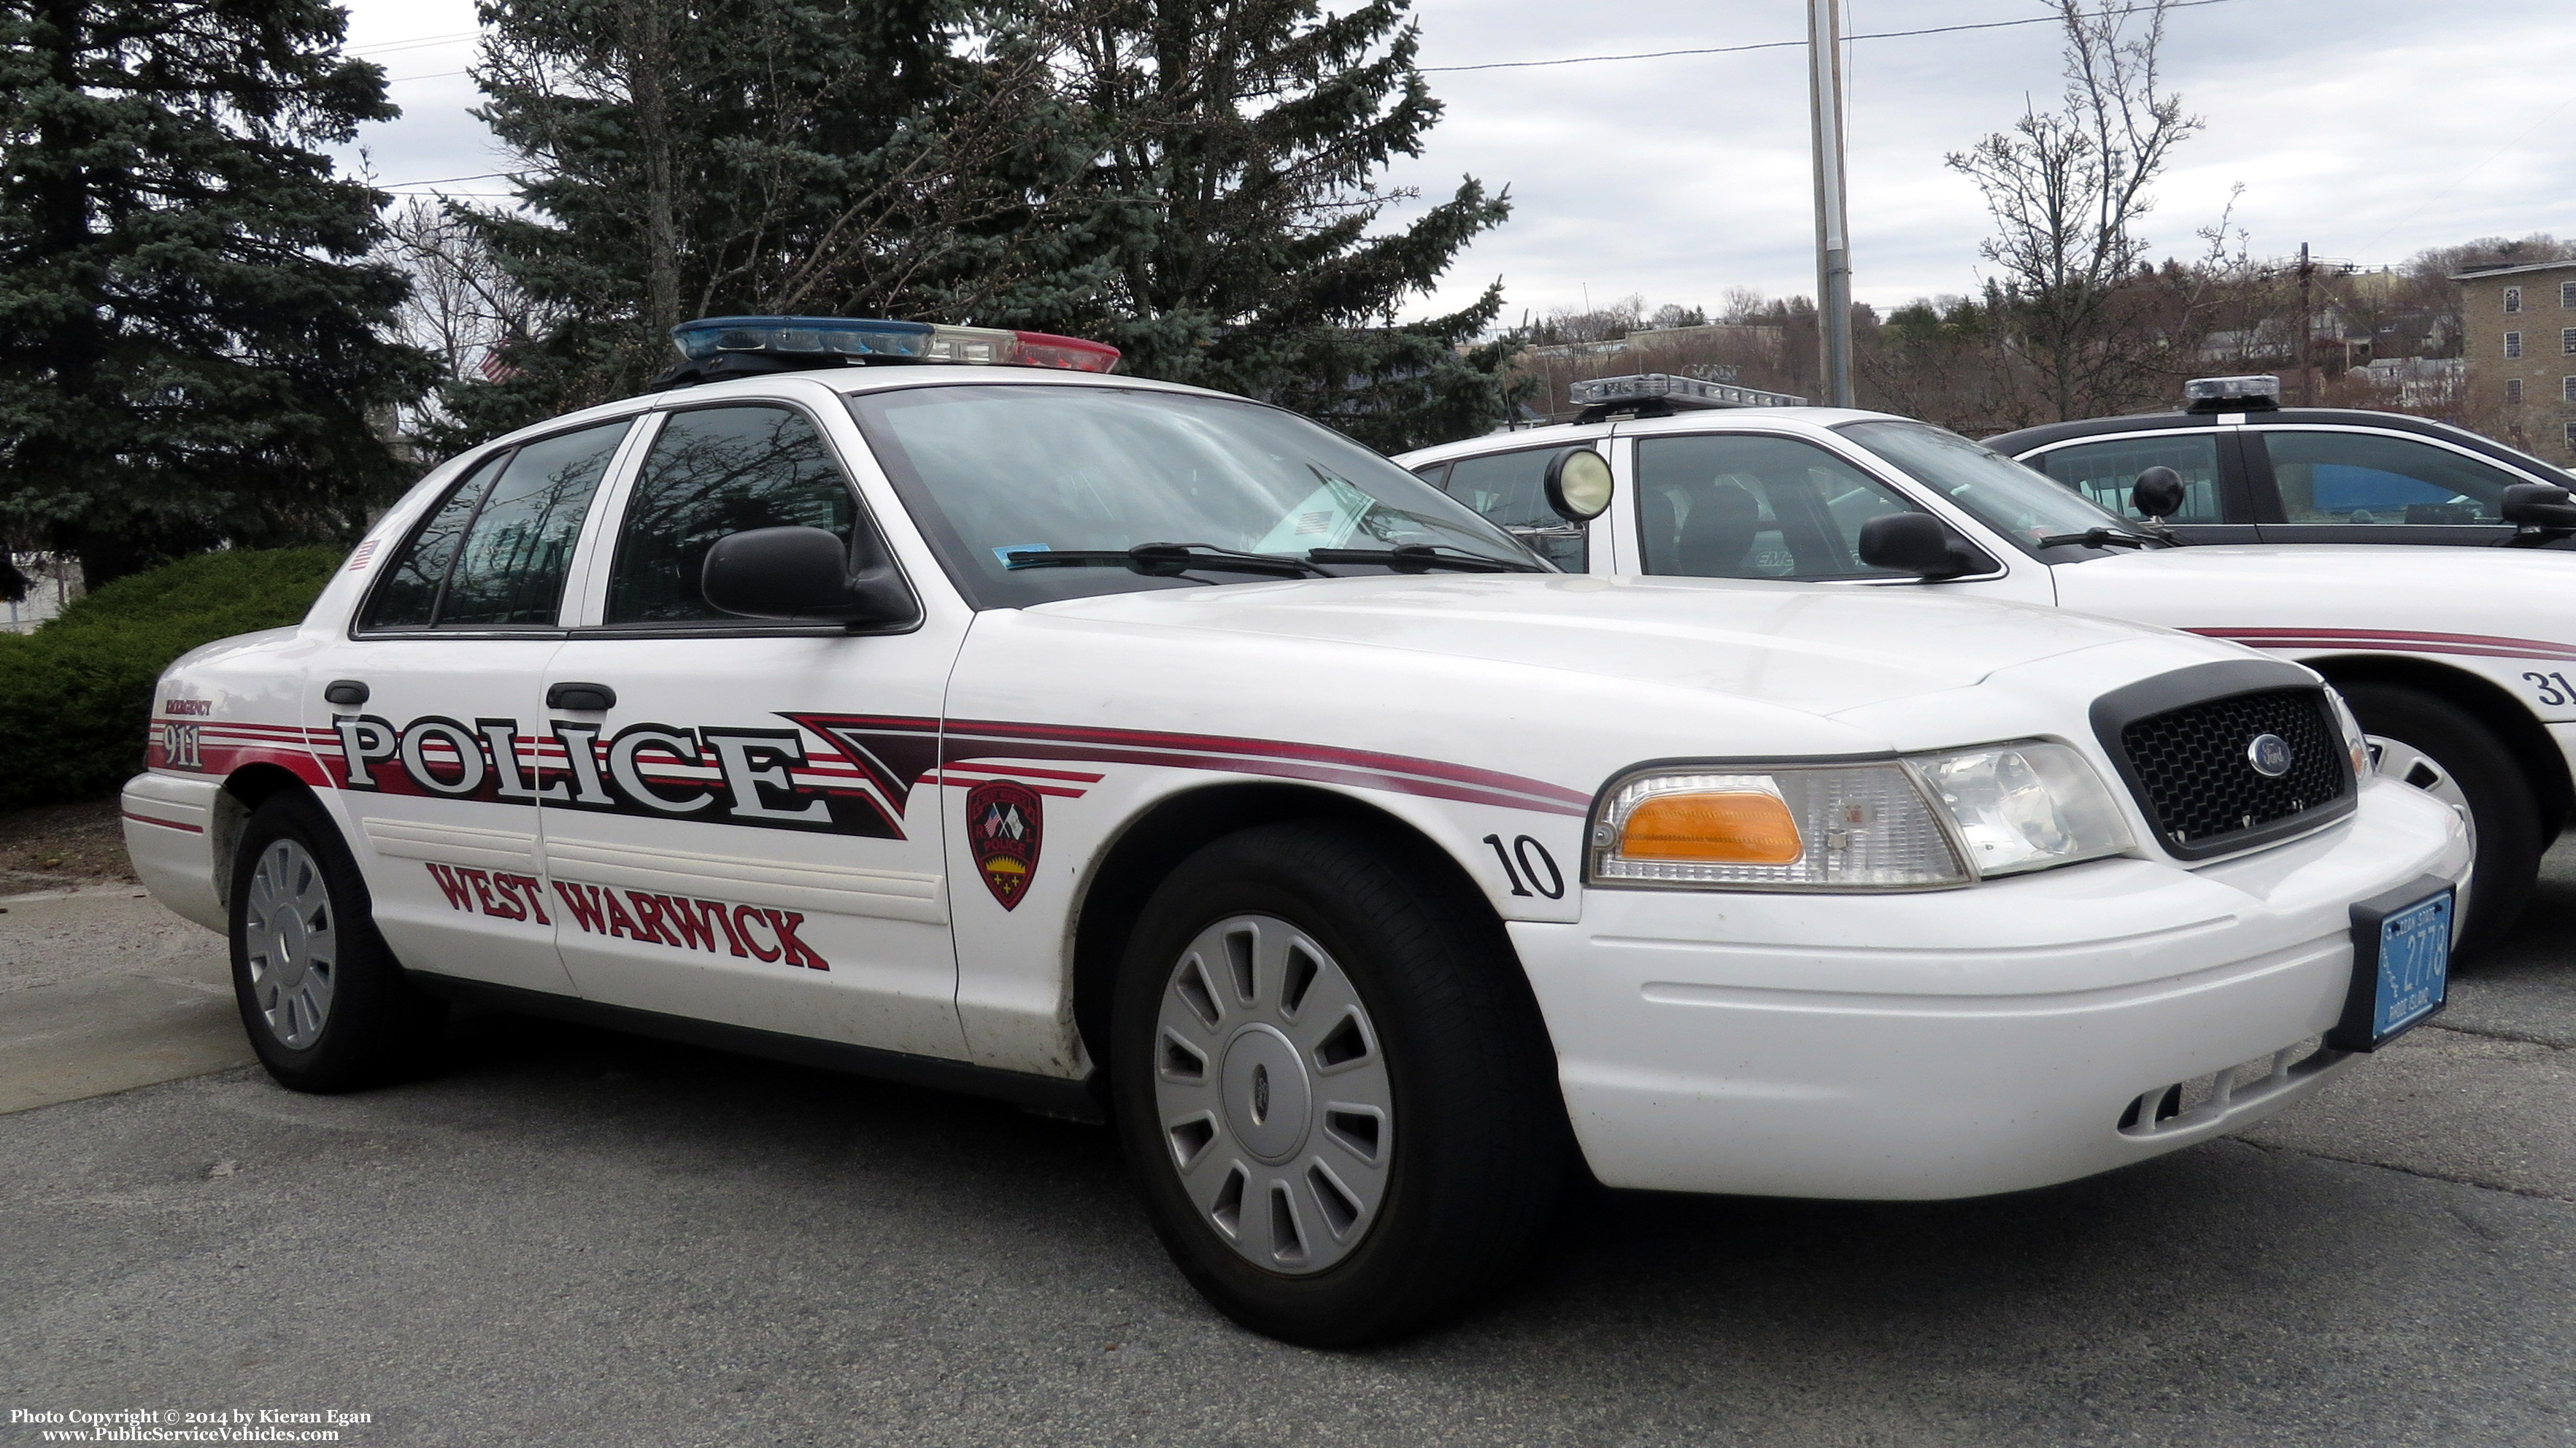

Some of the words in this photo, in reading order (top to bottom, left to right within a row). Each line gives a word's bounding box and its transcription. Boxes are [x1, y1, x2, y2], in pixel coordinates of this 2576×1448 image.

[2522, 671, 2576, 706] 31
[163, 722, 203, 769] 911
[332, 714, 833, 827] POLICE
[984, 838, 1026, 854] POLICE
[1482, 833, 1565, 900] 10
[425, 862, 551, 927] WEST
[551, 880, 830, 972] WARWICK
[2404, 925, 2445, 992] 2778
